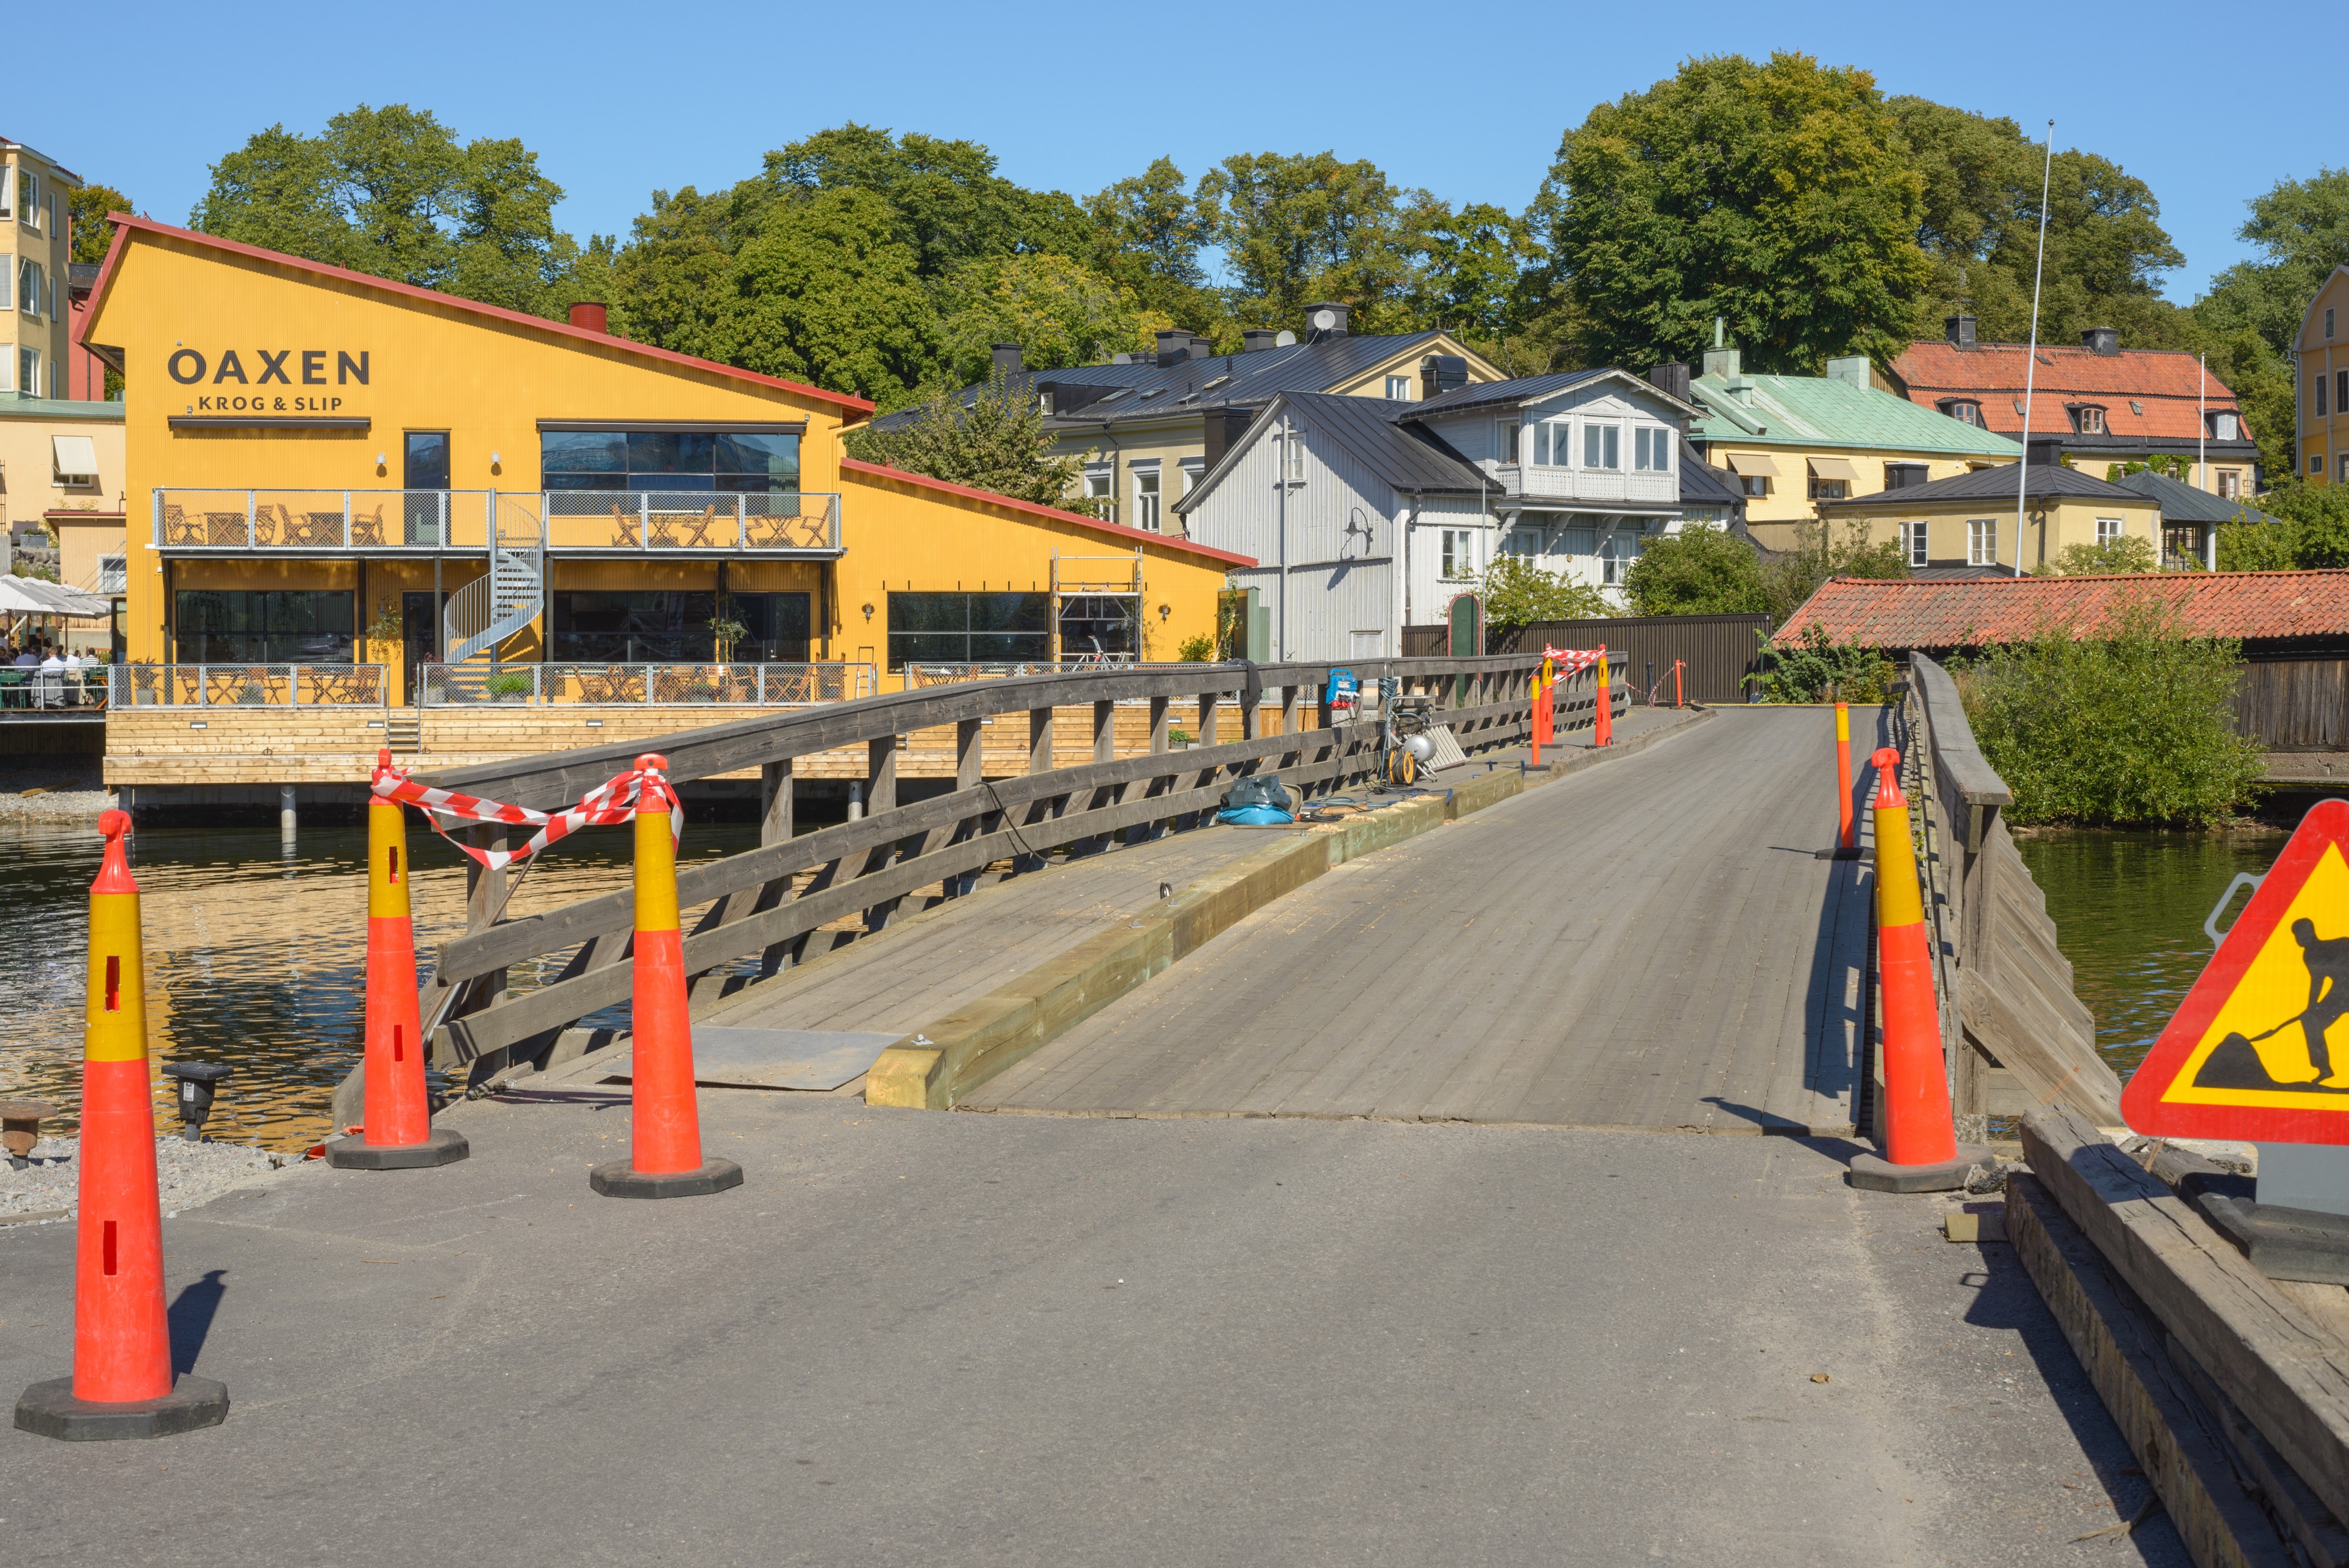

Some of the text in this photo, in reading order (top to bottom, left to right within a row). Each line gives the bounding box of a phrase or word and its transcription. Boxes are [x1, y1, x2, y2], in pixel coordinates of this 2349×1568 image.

[168, 348, 369, 385] OAXEN
[198, 396, 342, 410] KROG & SLIP
